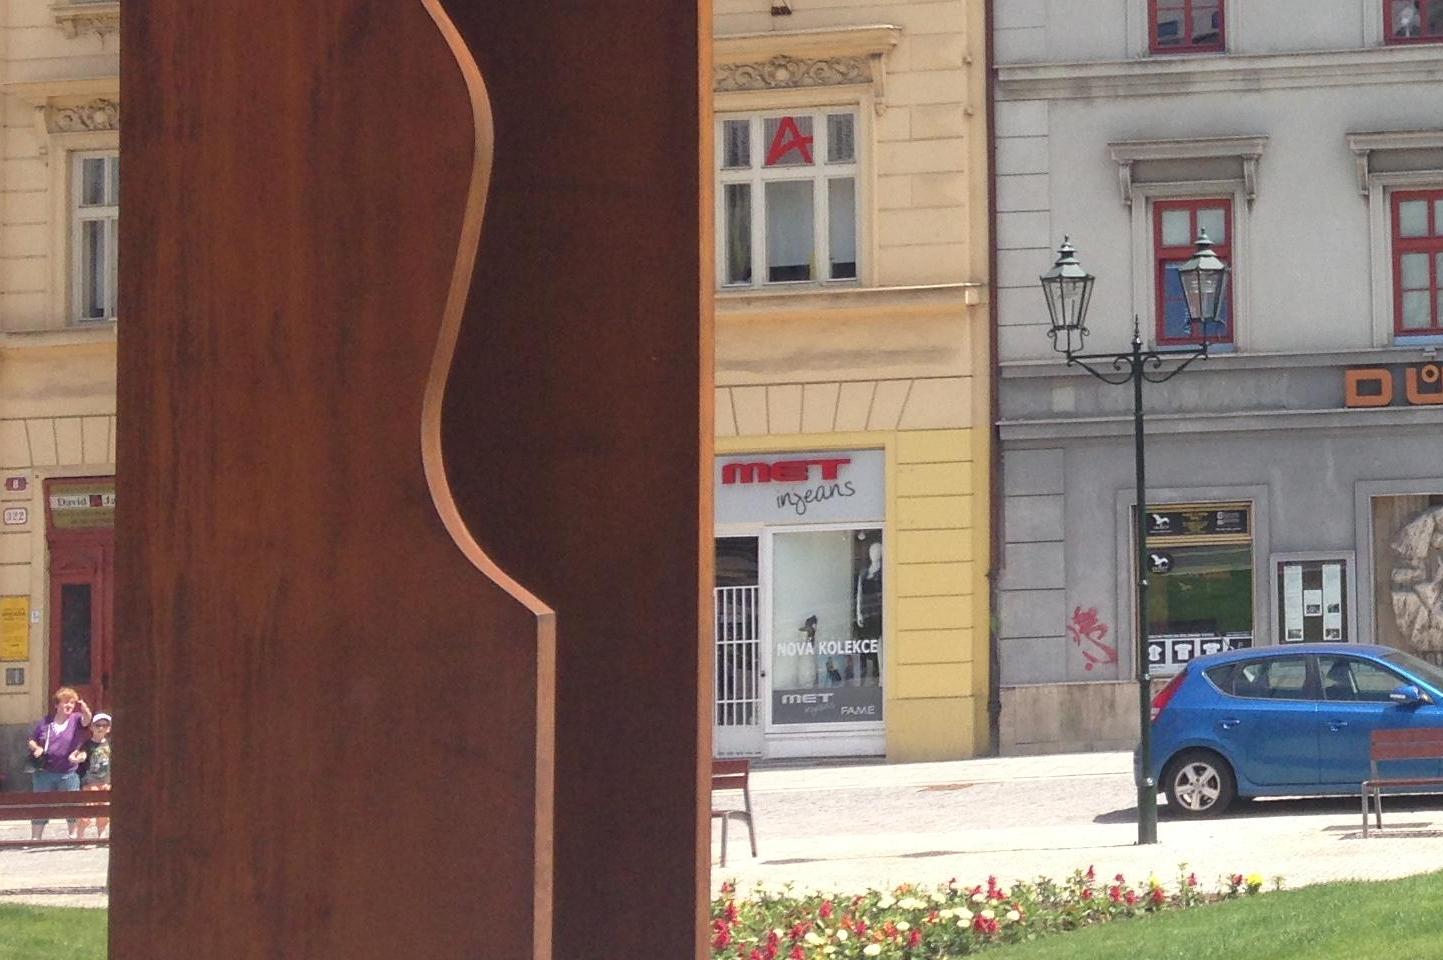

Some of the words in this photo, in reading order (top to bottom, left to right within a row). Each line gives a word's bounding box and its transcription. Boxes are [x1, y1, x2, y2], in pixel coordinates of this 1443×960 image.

[721, 458, 852, 484] MET
[819, 639, 879, 655] KOLEKCE
[840, 705, 876, 715] FAME
